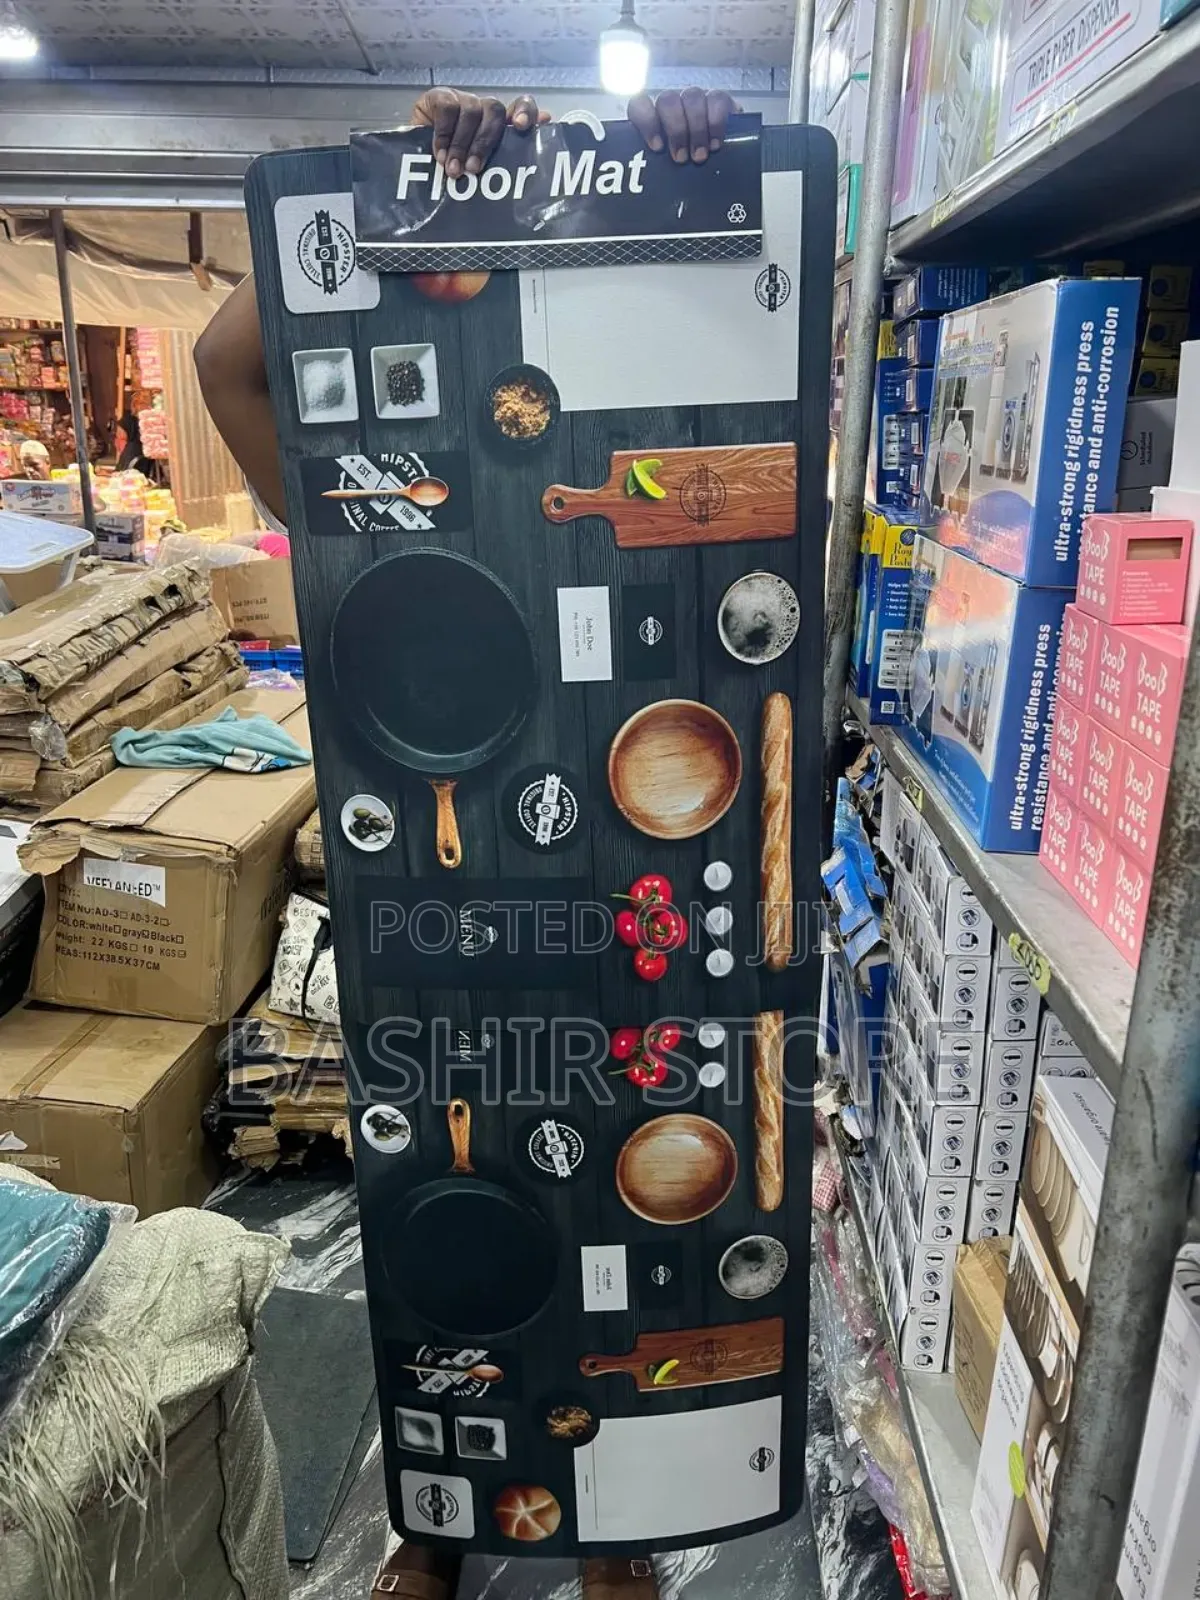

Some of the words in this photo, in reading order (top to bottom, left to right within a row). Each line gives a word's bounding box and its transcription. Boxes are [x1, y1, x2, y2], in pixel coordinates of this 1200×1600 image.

[396, 153, 537, 201] Floor
[550, 150, 647, 196] Mat
[1077, 320, 1095, 373] press
[1091, 306, 1120, 435] anti-corrosion
[1064, 375, 1087, 459] rigidness
[381, 453, 418, 479] HIPST
[1088, 435, 1104, 470] and
[1053, 460, 1081, 562] ultra-strong
[1084, 562, 1105, 586] TAPE
[1033, 623, 1050, 668] press
[1066, 653, 1084, 677] TAPE
[1100, 671, 1120, 699] TAPE
[1021, 669, 1044, 741] rigidness
[1137, 692, 1162, 723] TAPE
[1056, 740, 1073, 767] TAPE
[1010, 741, 1036, 831] ultra-strong
[1089, 765, 1109, 796] TAPE
[1125, 795, 1148, 829] TAPE
[1048, 823, 1067, 855] TAPE
[1079, 856, 1099, 888] TAPE
[1114, 893, 1136, 928] TAPE
[91, 936, 104, 946] 22
[143, 944, 154, 955] 19
[459, 909, 475, 957] MENU
